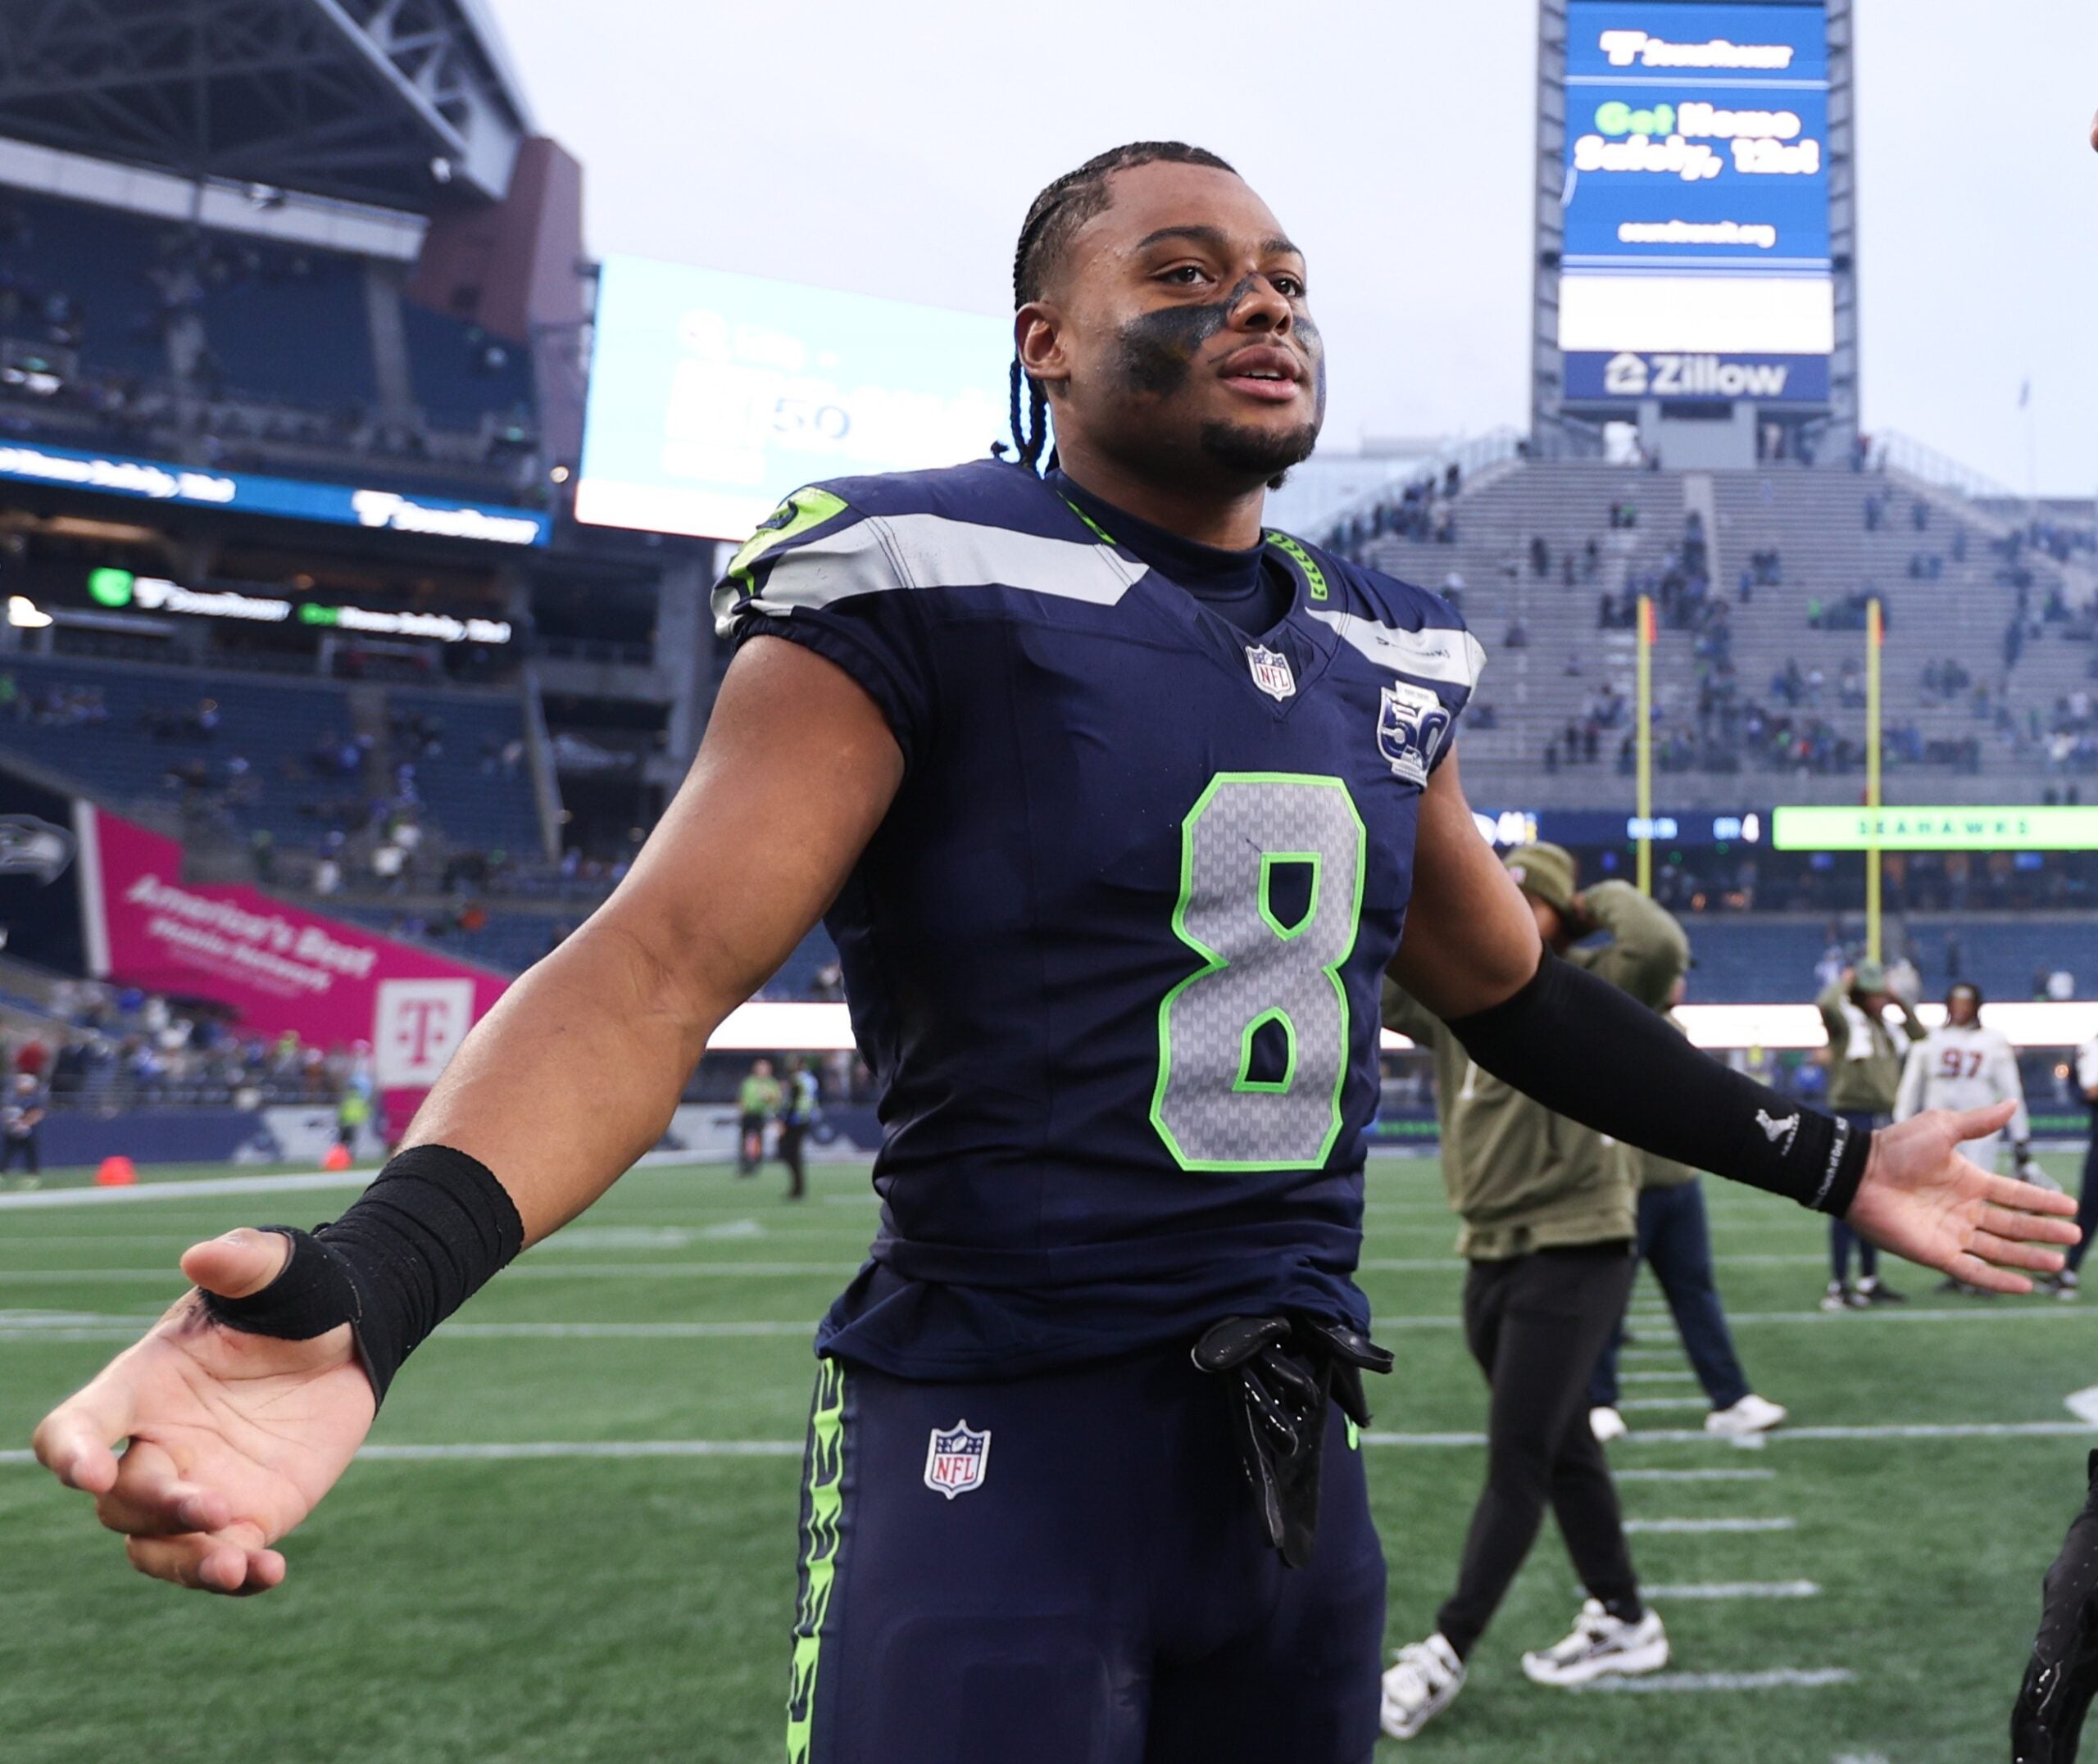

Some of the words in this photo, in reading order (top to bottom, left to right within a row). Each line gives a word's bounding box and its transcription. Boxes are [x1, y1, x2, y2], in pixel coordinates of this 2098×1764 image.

[1595, 102, 1674, 136] Get
[1650, 354, 1789, 397] Zillow
[1259, 665, 1289, 691] NFL
[128, 873, 294, 951] America's
[295, 927, 376, 978] Best
[1149, 772, 1366, 1172] 8
[1938, 1047, 1985, 1079] 97
[935, 1456, 975, 1485] NFL
